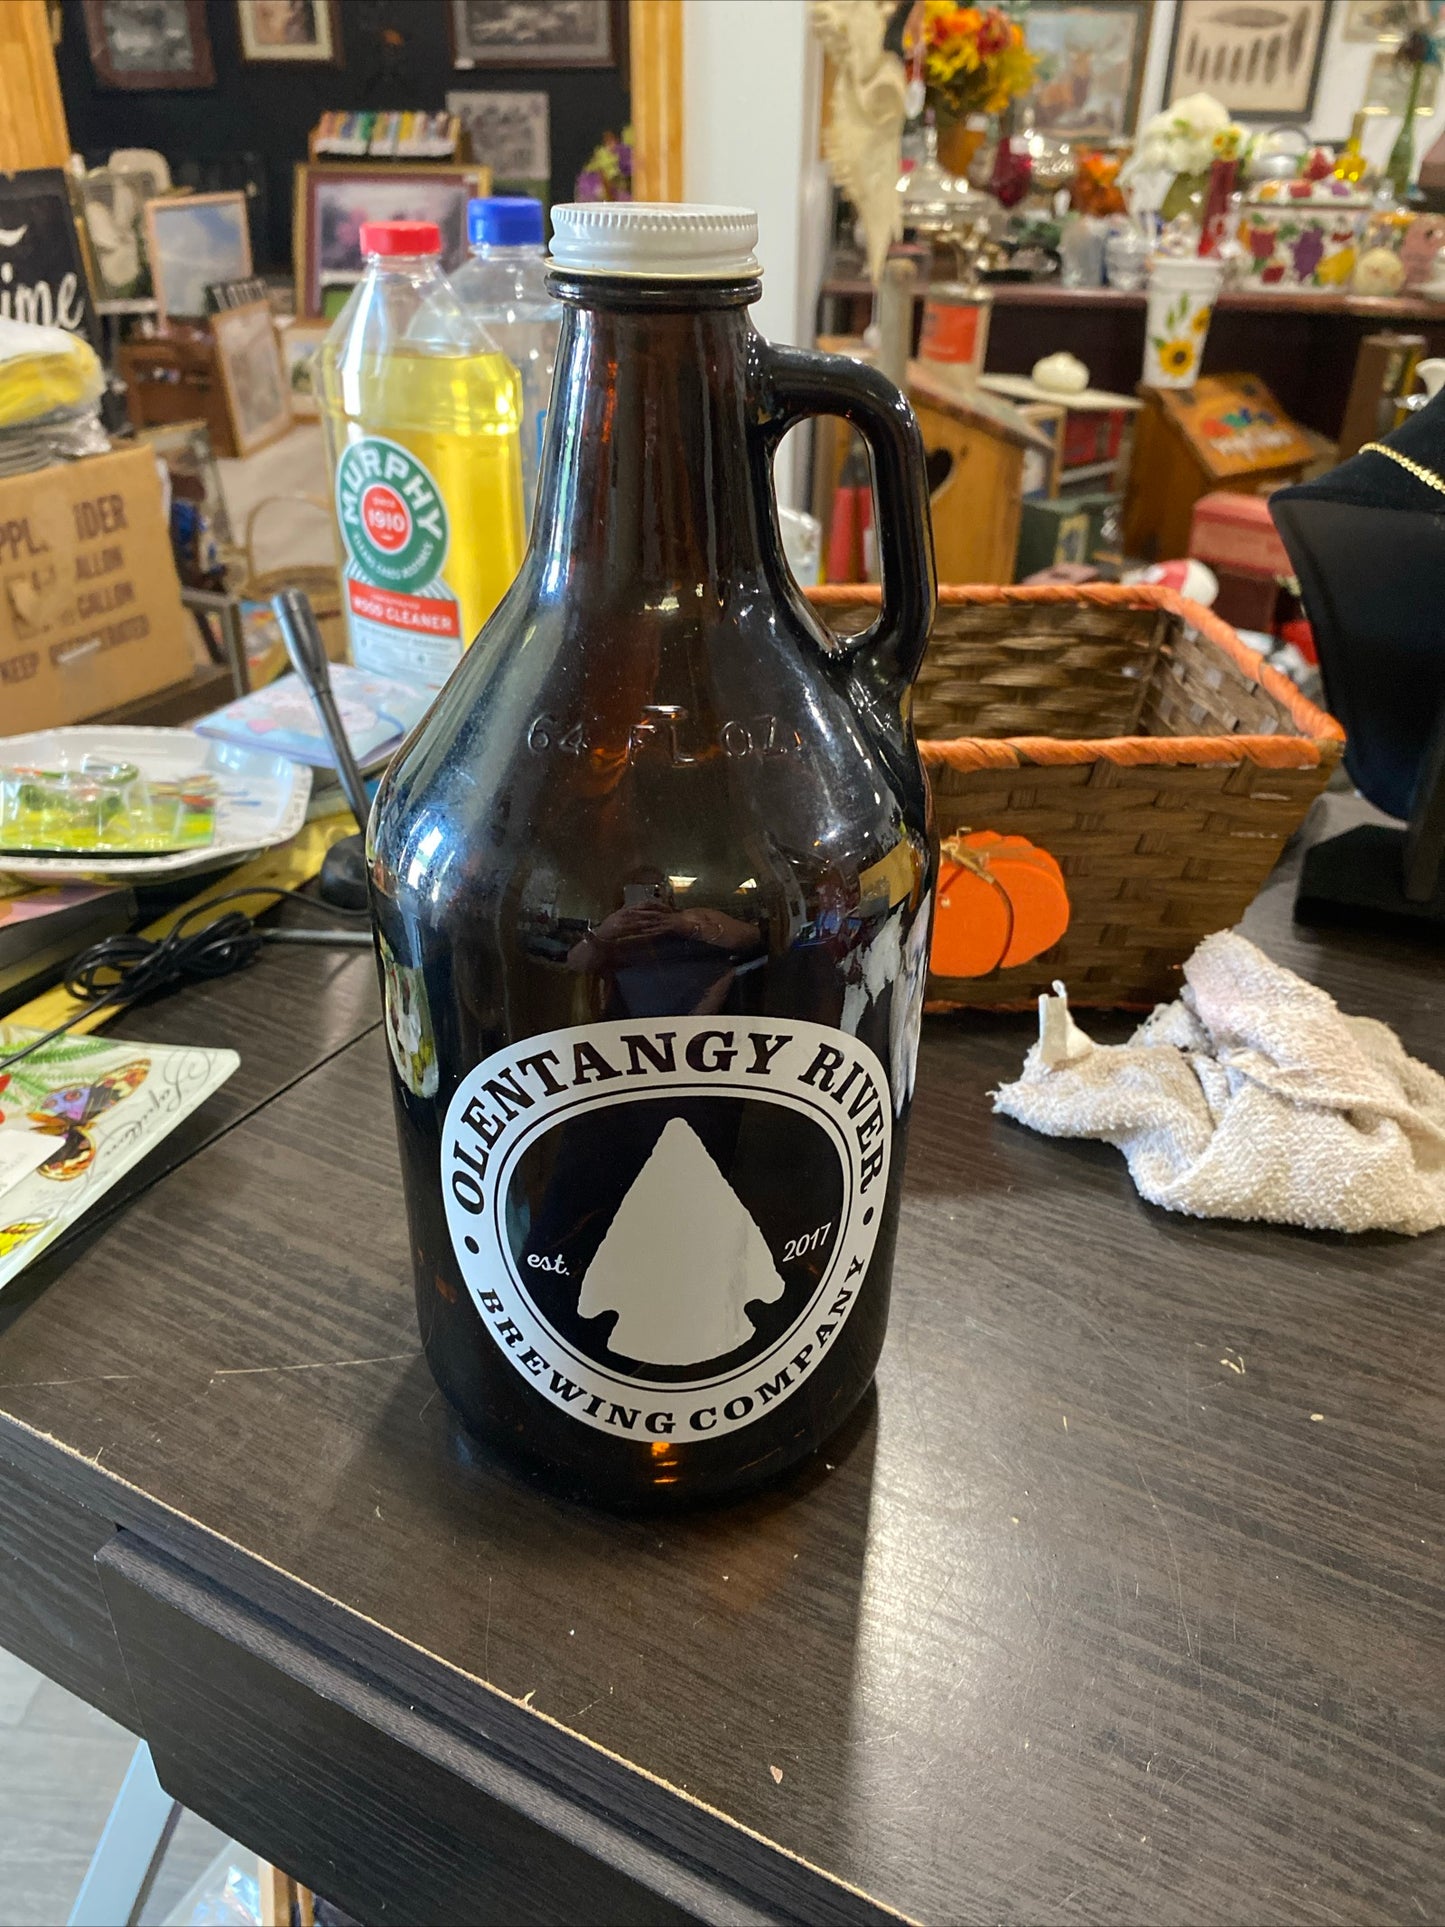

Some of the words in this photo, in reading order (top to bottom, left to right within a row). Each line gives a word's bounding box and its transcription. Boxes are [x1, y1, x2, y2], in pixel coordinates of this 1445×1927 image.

[0, 262, 85, 330] ime
[342, 447, 443, 540] MURPHY
[73, 494, 129, 541] IDER
[368, 508, 406, 533] 1910
[386, 606, 453, 632] CLEANER
[527, 713, 589, 757] 64
[452, 1030, 793, 1215] OLENTANGY
[797, 1042, 885, 1195] RIVER
[526, 1253, 571, 1276] est.
[782, 1222, 832, 1263] 2017
[477, 1288, 676, 1434] BREWING
[689, 1255, 864, 1431] COMPANY
